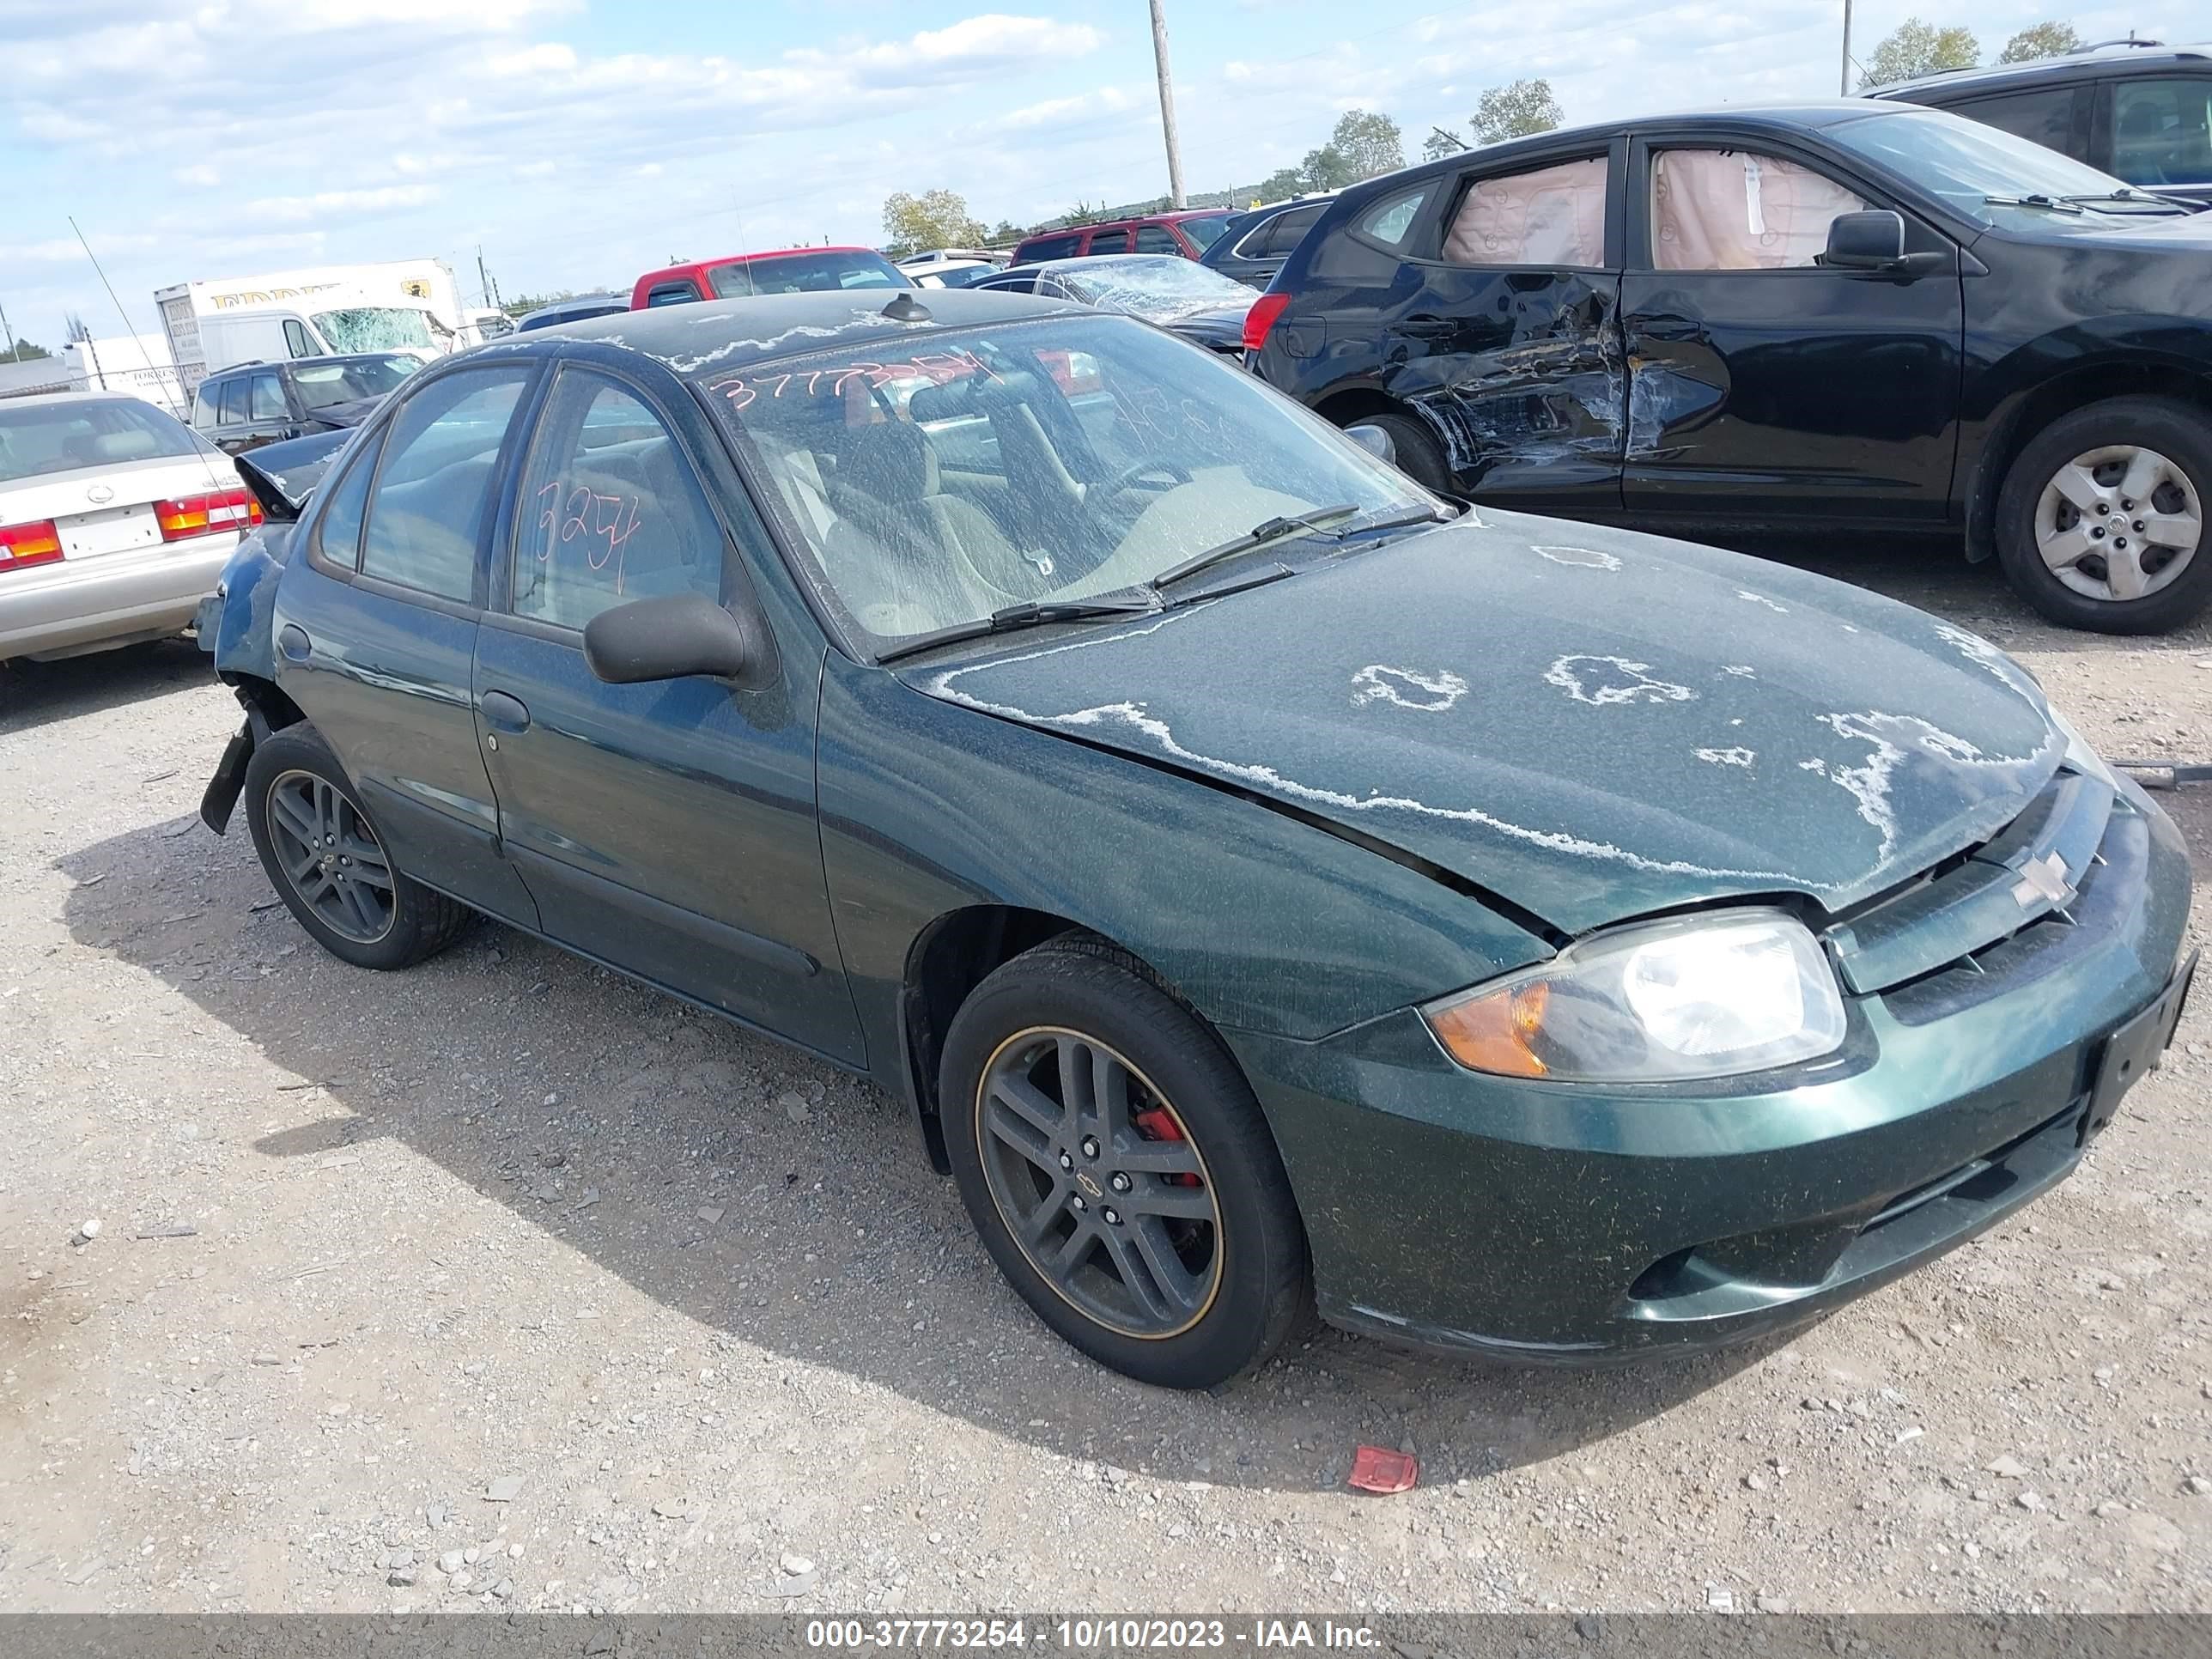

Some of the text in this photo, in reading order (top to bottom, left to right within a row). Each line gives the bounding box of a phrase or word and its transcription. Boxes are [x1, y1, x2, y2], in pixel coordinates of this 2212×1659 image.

[133, 369, 175, 381] TORRES
[709, 350, 1006, 409] 37773254
[537, 482, 641, 596] 3254
